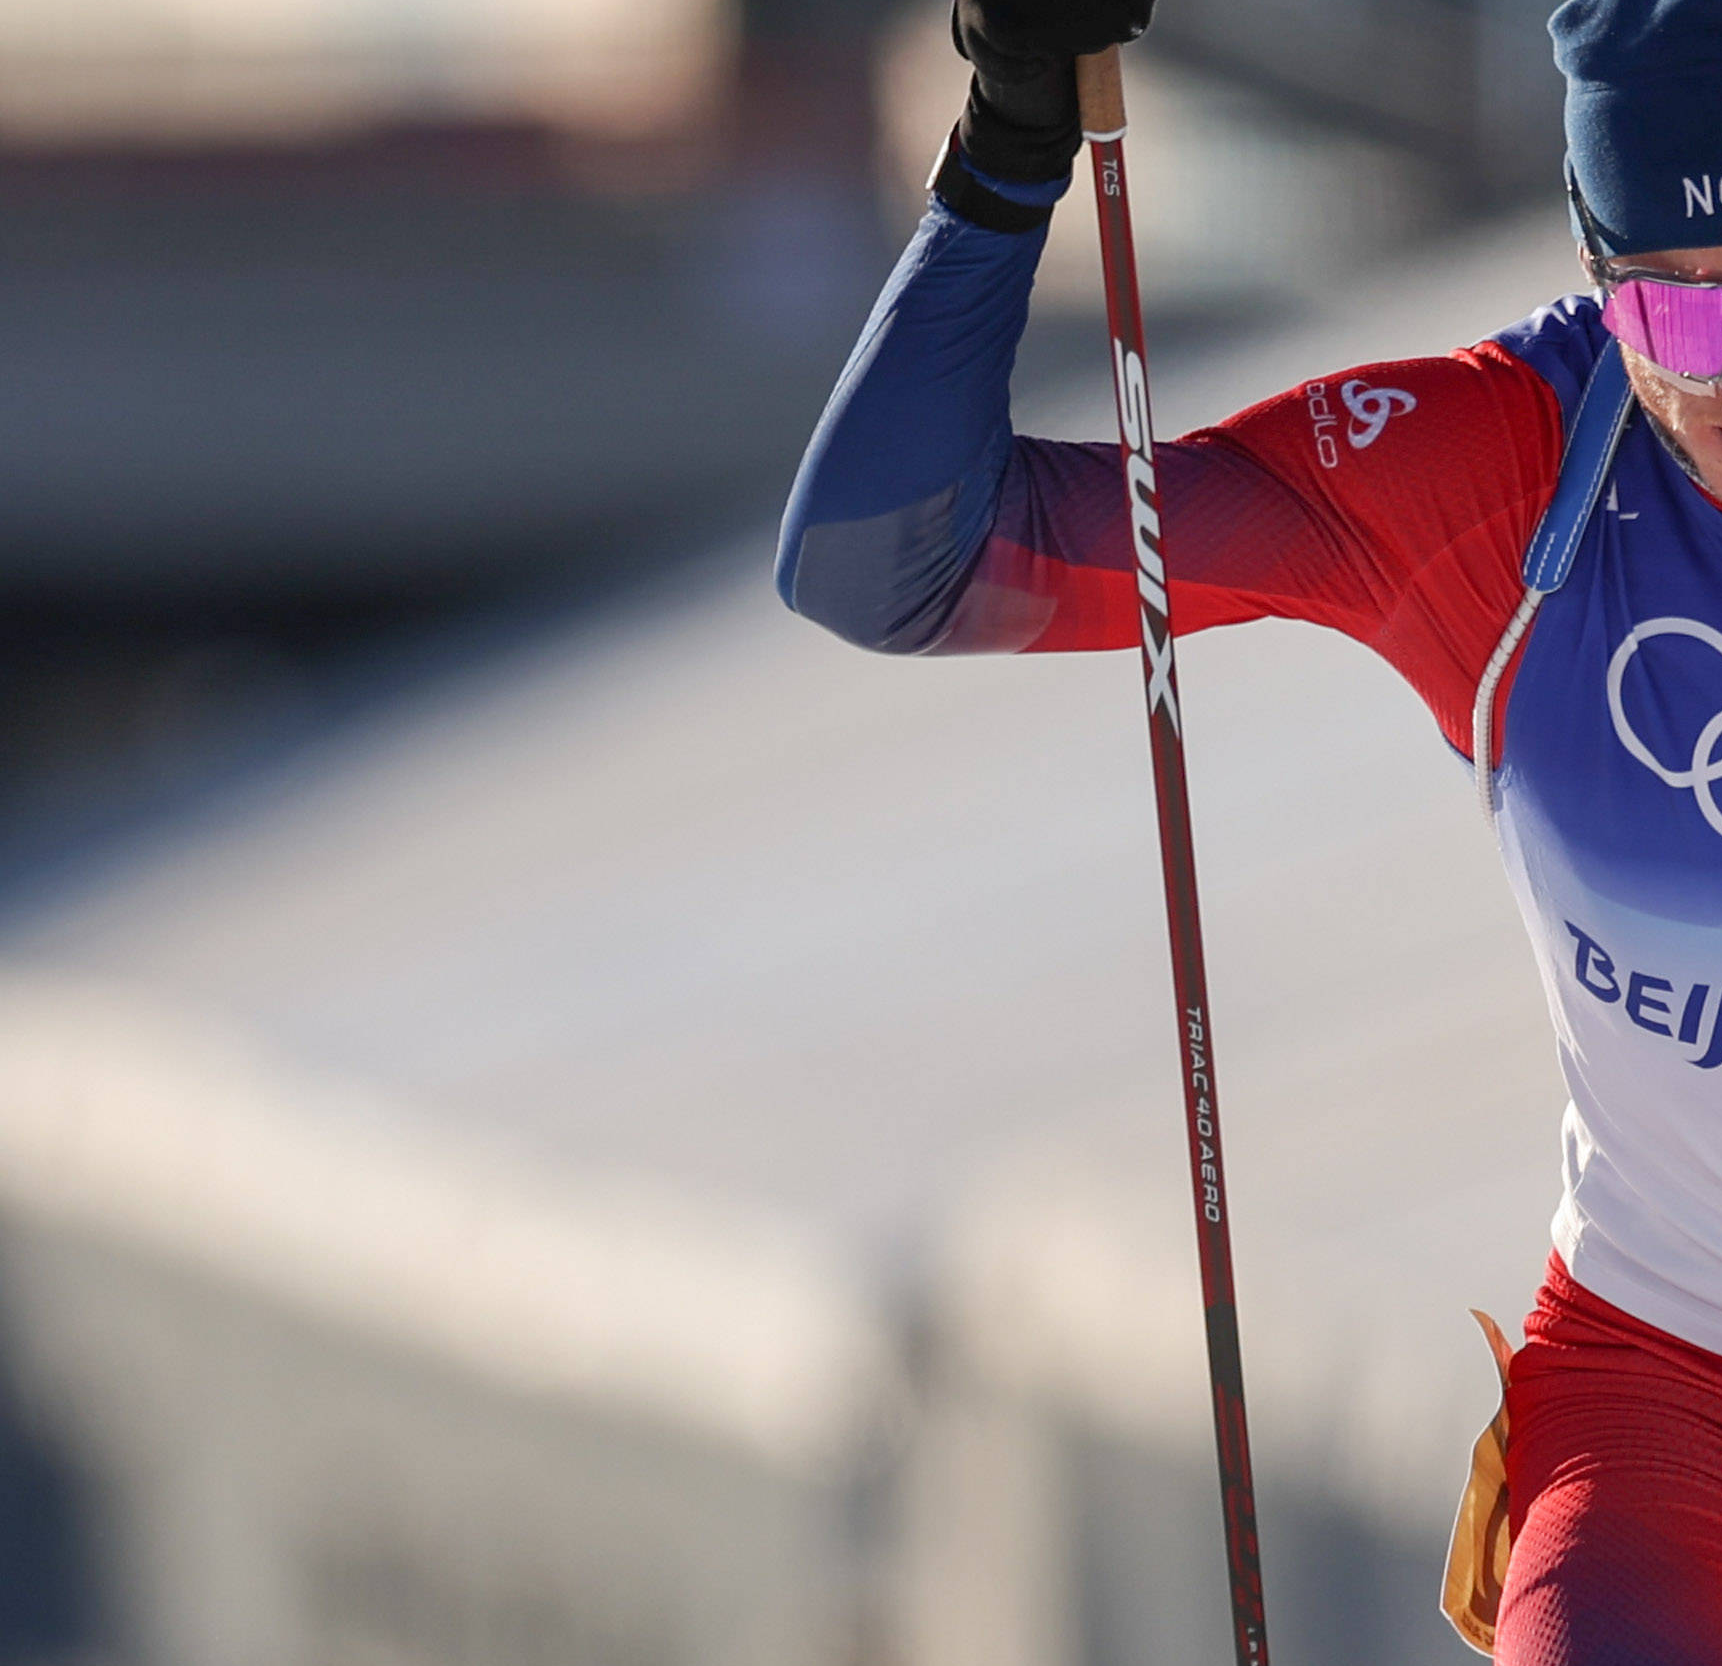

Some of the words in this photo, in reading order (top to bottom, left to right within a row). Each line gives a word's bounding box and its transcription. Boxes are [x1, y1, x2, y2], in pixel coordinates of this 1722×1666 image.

[1102, 158, 1120, 197] TCS
[1306, 382, 1338, 469] odlo
[1186, 1006, 1208, 1092] TRIAC
[1199, 1141, 1221, 1224] AERO
